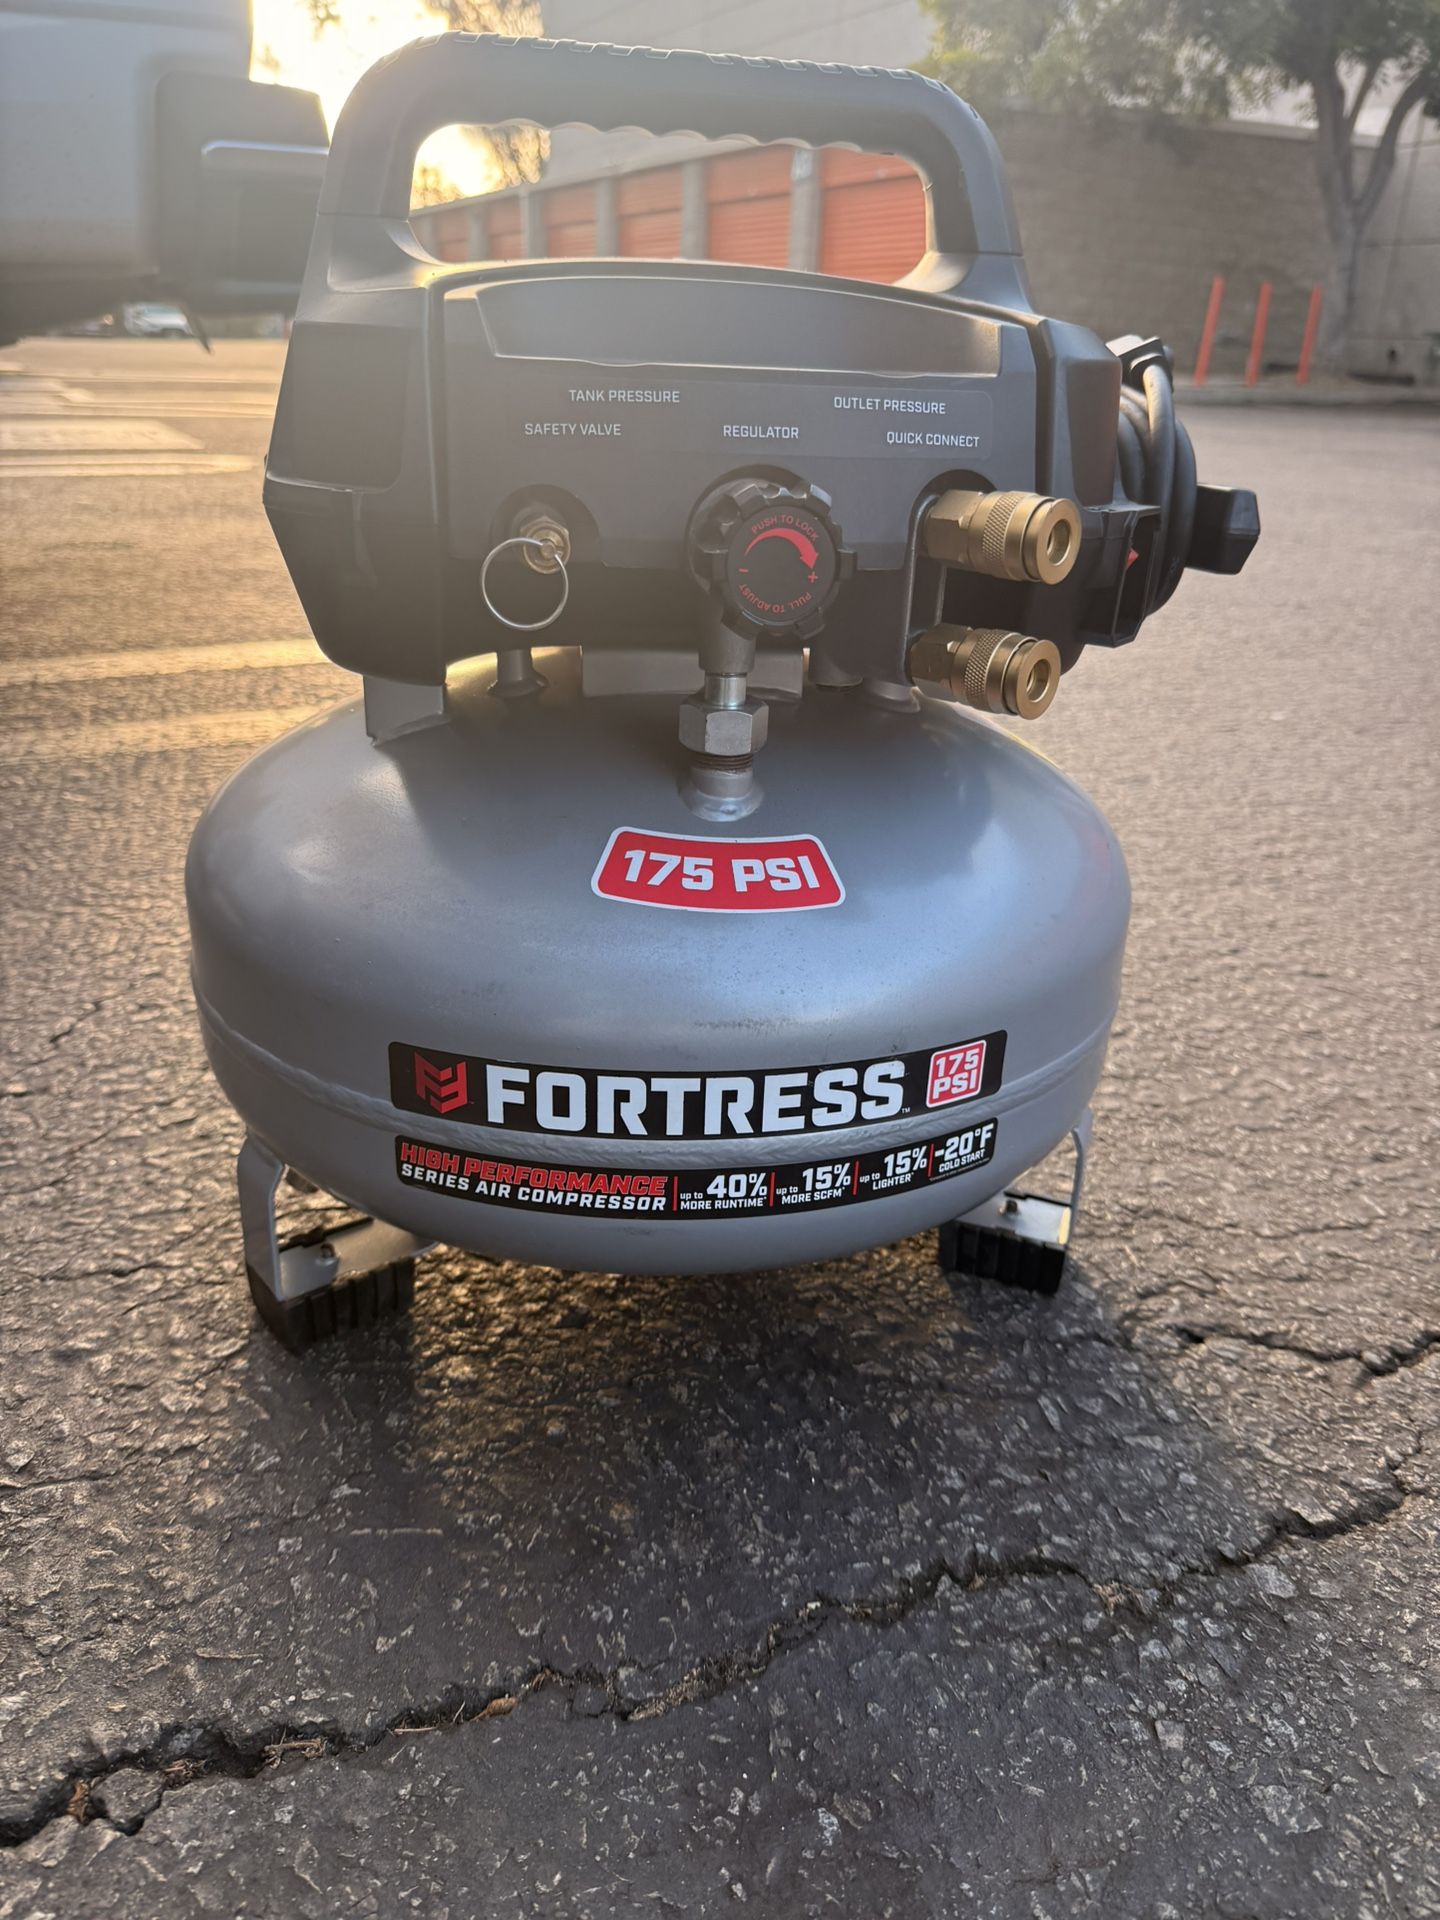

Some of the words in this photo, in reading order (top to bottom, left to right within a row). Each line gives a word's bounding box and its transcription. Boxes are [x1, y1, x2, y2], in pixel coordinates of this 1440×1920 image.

[569, 389, 605, 402] TANK
[608, 390, 680, 403] PRESSURE
[834, 396, 881, 411] OUTLET
[884, 399, 946, 414] PRESSURE
[524, 423, 577, 436] SAFETY
[580, 424, 622, 436] VALVE
[723, 425, 799, 439] REGULATOR
[886, 431, 923, 445] QUICK
[926, 434, 980, 448] CONNECT
[751, 515, 778, 533] PUSH
[781, 514, 794, 525] TO
[795, 517, 820, 541] LOCK
[739, 583, 769, 611] ADJUST
[773, 603, 785, 613] TO
[789, 592, 812, 609] PULL
[624, 849, 714, 891] 175
[731, 855, 820, 893] PSI
[936, 1048, 980, 1077] 175
[932, 1069, 977, 1099] PSI
[486, 1060, 906, 1136] FORTRESS
[935, 1123, 994, 1161] -20°F
[400, 1142, 460, 1175] HIGH
[463, 1157, 668, 1196] PERFORMANCE
[859, 1175, 870, 1183] up
[871, 1172, 880, 1180] to
[884, 1145, 928, 1177] 15%
[939, 1158, 960, 1173] COLD
[961, 1148, 985, 1165] START
[401, 1163, 470, 1191] SERIES
[475, 1180, 511, 1198] AIR
[517, 1187, 667, 1211] COMPRESSOR
[680, 1192, 692, 1200] up
[693, 1191, 704, 1199] to
[706, 1172, 768, 1198] 40%
[776, 1187, 788, 1195] up
[789, 1185, 798, 1194] to
[802, 1163, 851, 1191] 15%
[680, 1200, 712, 1210] MORE
[782, 1193, 811, 1205] MORE
